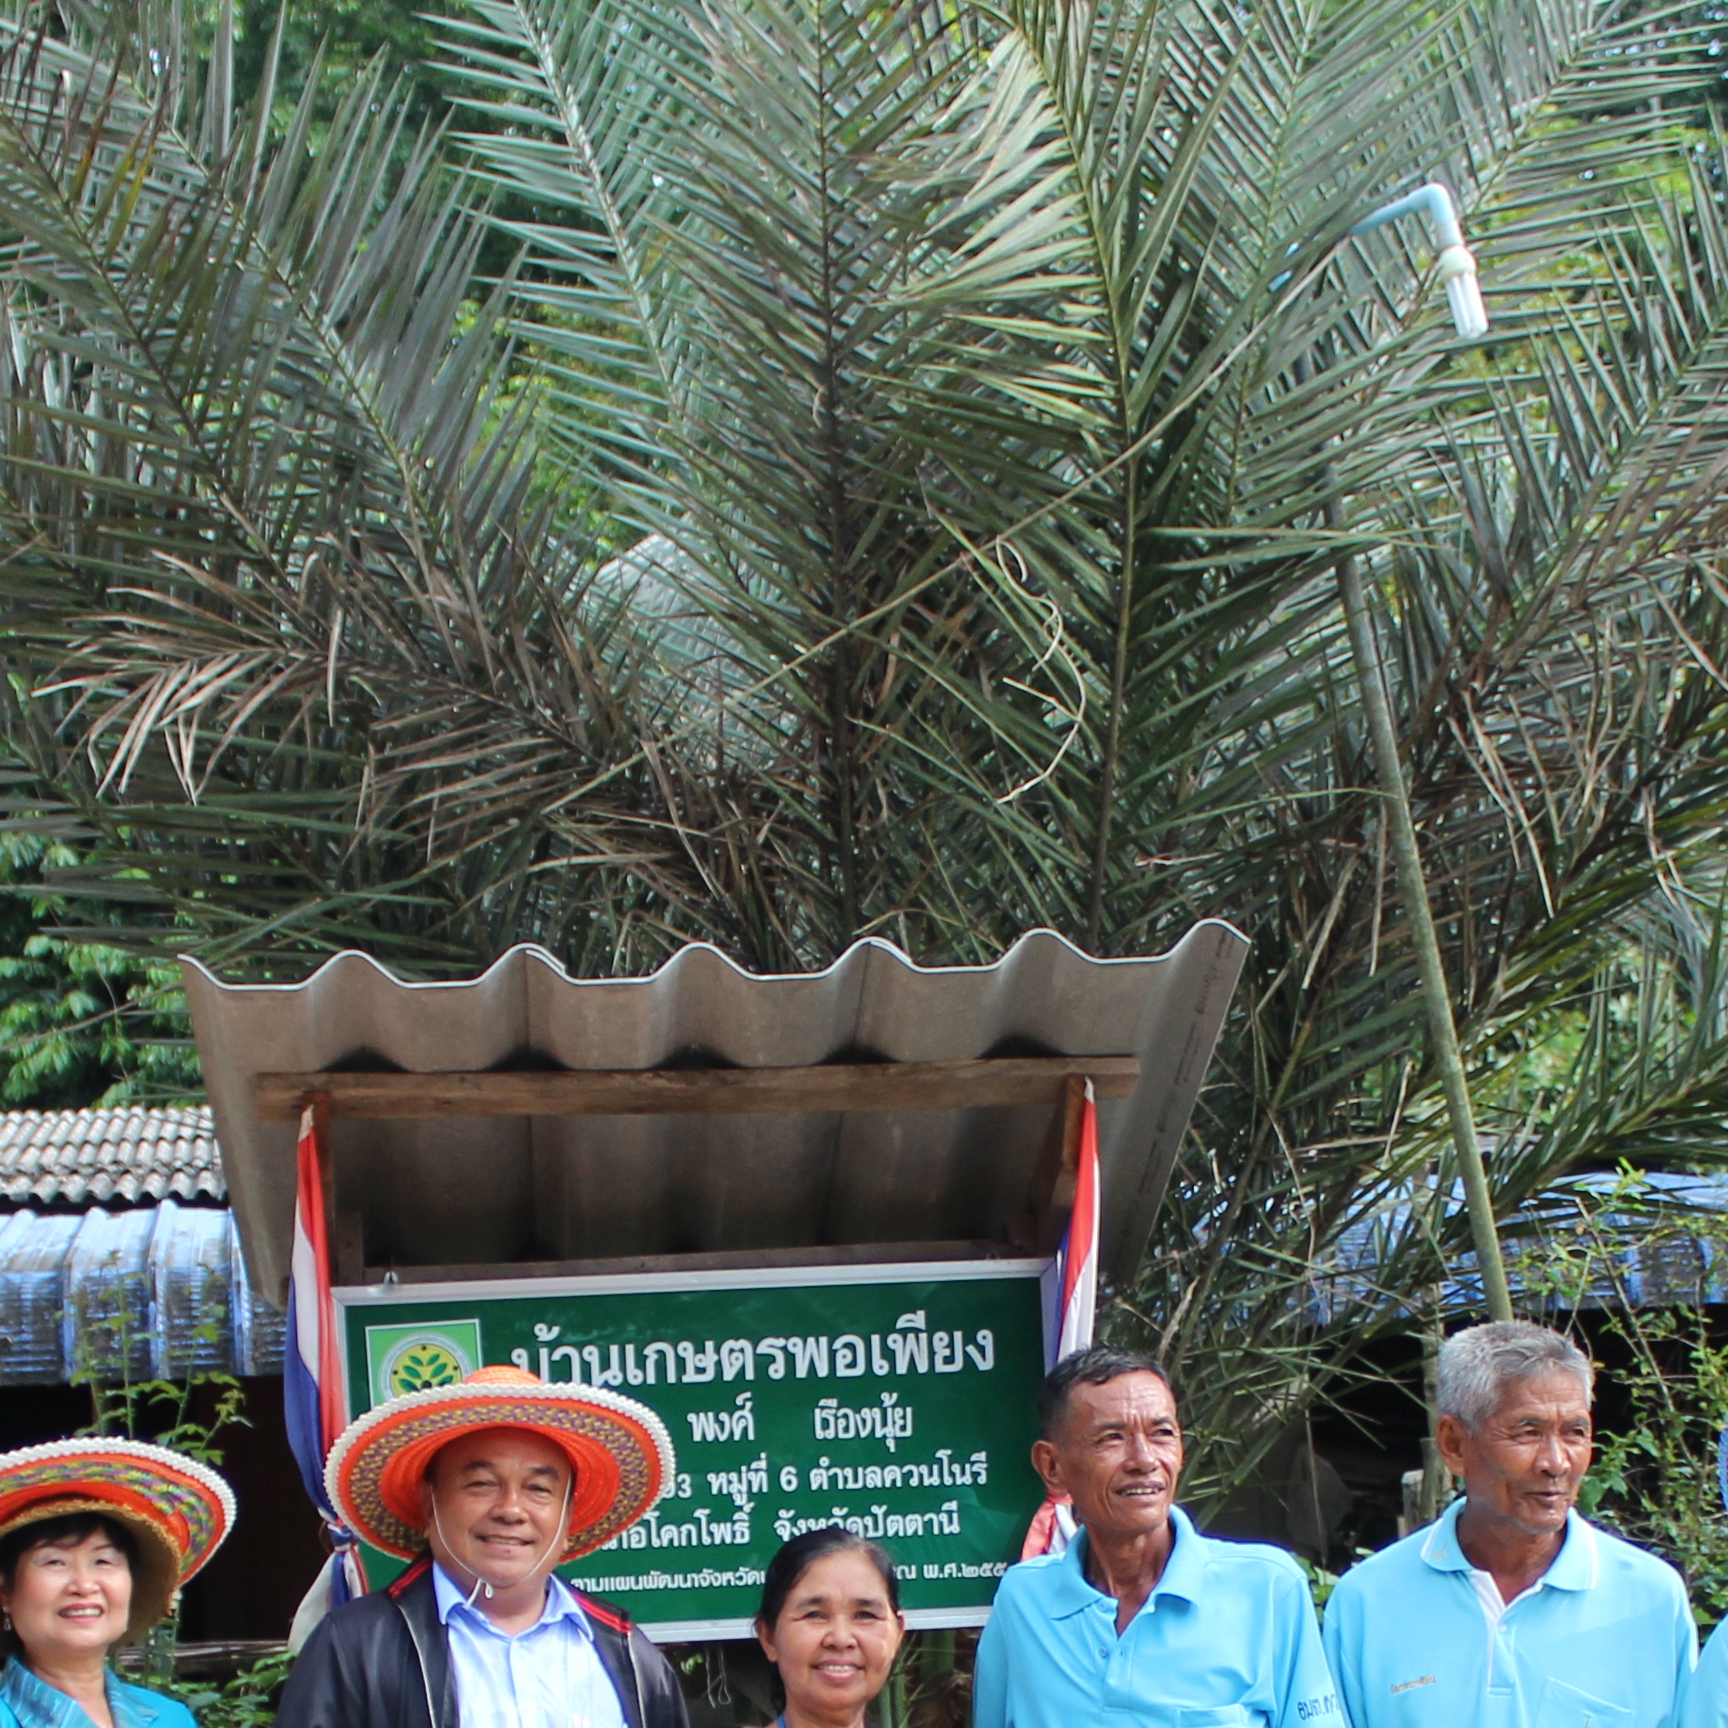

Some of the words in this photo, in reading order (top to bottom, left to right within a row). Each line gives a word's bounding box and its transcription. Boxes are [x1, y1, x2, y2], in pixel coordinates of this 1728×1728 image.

[511, 1310, 995, 1386] บ้านเกษตรพอเพียง
[686, 1391, 755, 1442] พงศ์
[814, 1392, 914, 1452] เรืองนุ้ย
[706, 1452, 769, 1506] หมู่ที่
[779, 1465, 799, 1492] 6
[809, 1449, 989, 1491] ตำบลควนโนรี
[773, 1500, 961, 1542] จังหวัดปัตตานี
[570, 1566, 766, 1594] ตามแผนพัฒนาจังหวัด
